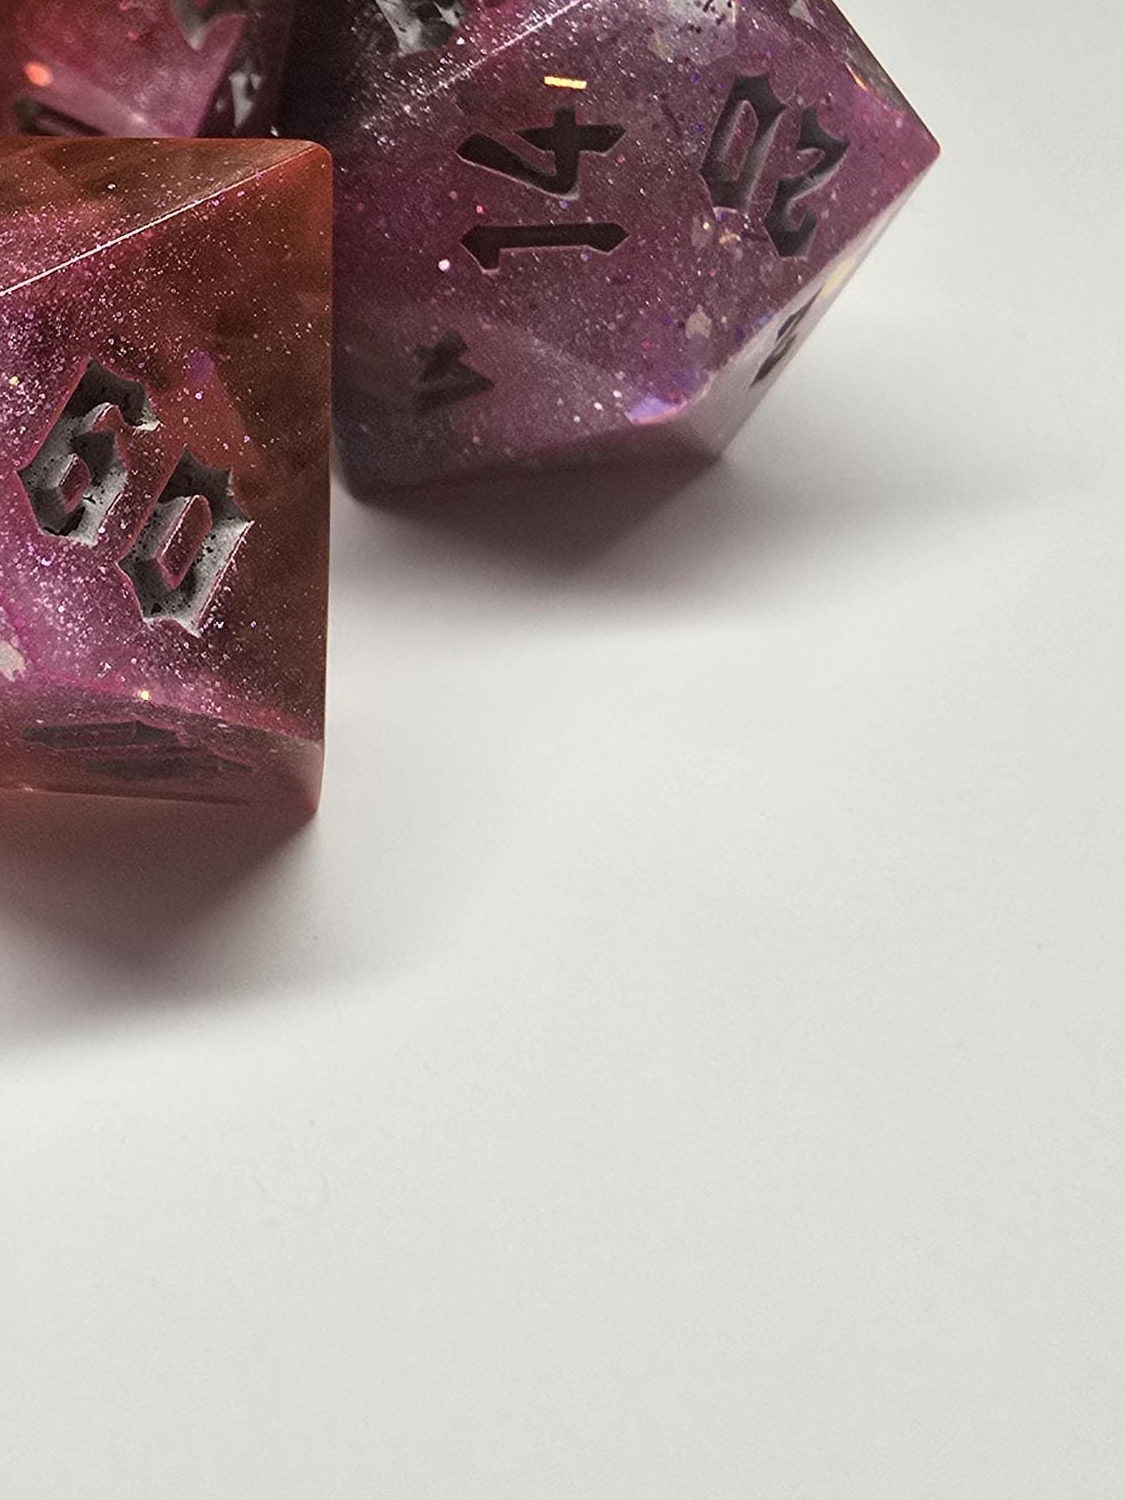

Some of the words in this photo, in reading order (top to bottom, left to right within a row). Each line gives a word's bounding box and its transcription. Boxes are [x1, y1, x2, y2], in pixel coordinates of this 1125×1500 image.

[456, 105, 630, 276] 14
[699, 73, 851, 261] 20
[13, 355, 256, 639] 60
